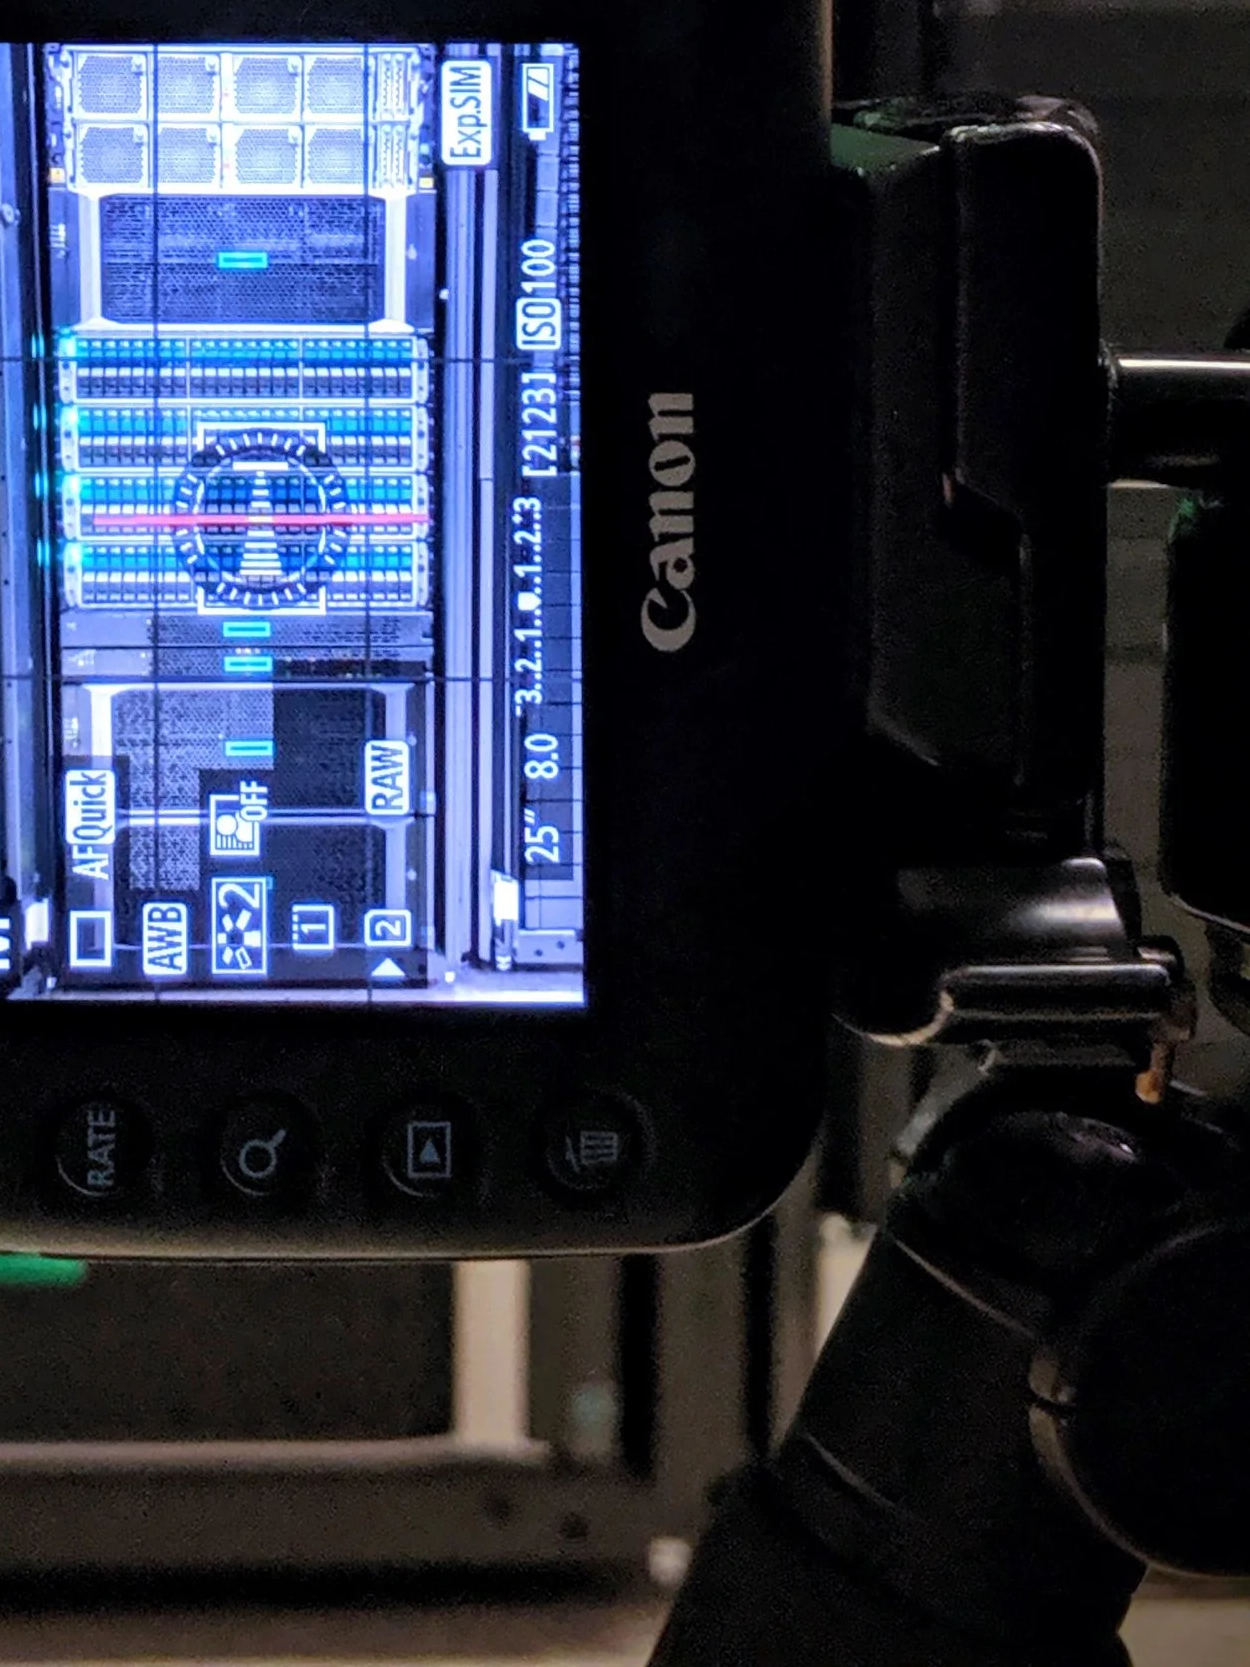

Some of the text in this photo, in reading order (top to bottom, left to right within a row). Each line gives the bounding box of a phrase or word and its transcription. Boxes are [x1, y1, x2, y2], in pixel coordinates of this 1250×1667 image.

[450, 66, 487, 159] Exp.SIM
[640, 393, 696, 652] Canon
[370, 743, 404, 811] RAW
[524, 733, 559, 780] 8.0
[239, 781, 268, 821] OFF
[147, 906, 182, 971] AWB
[87, 1109, 115, 1186] RATE
